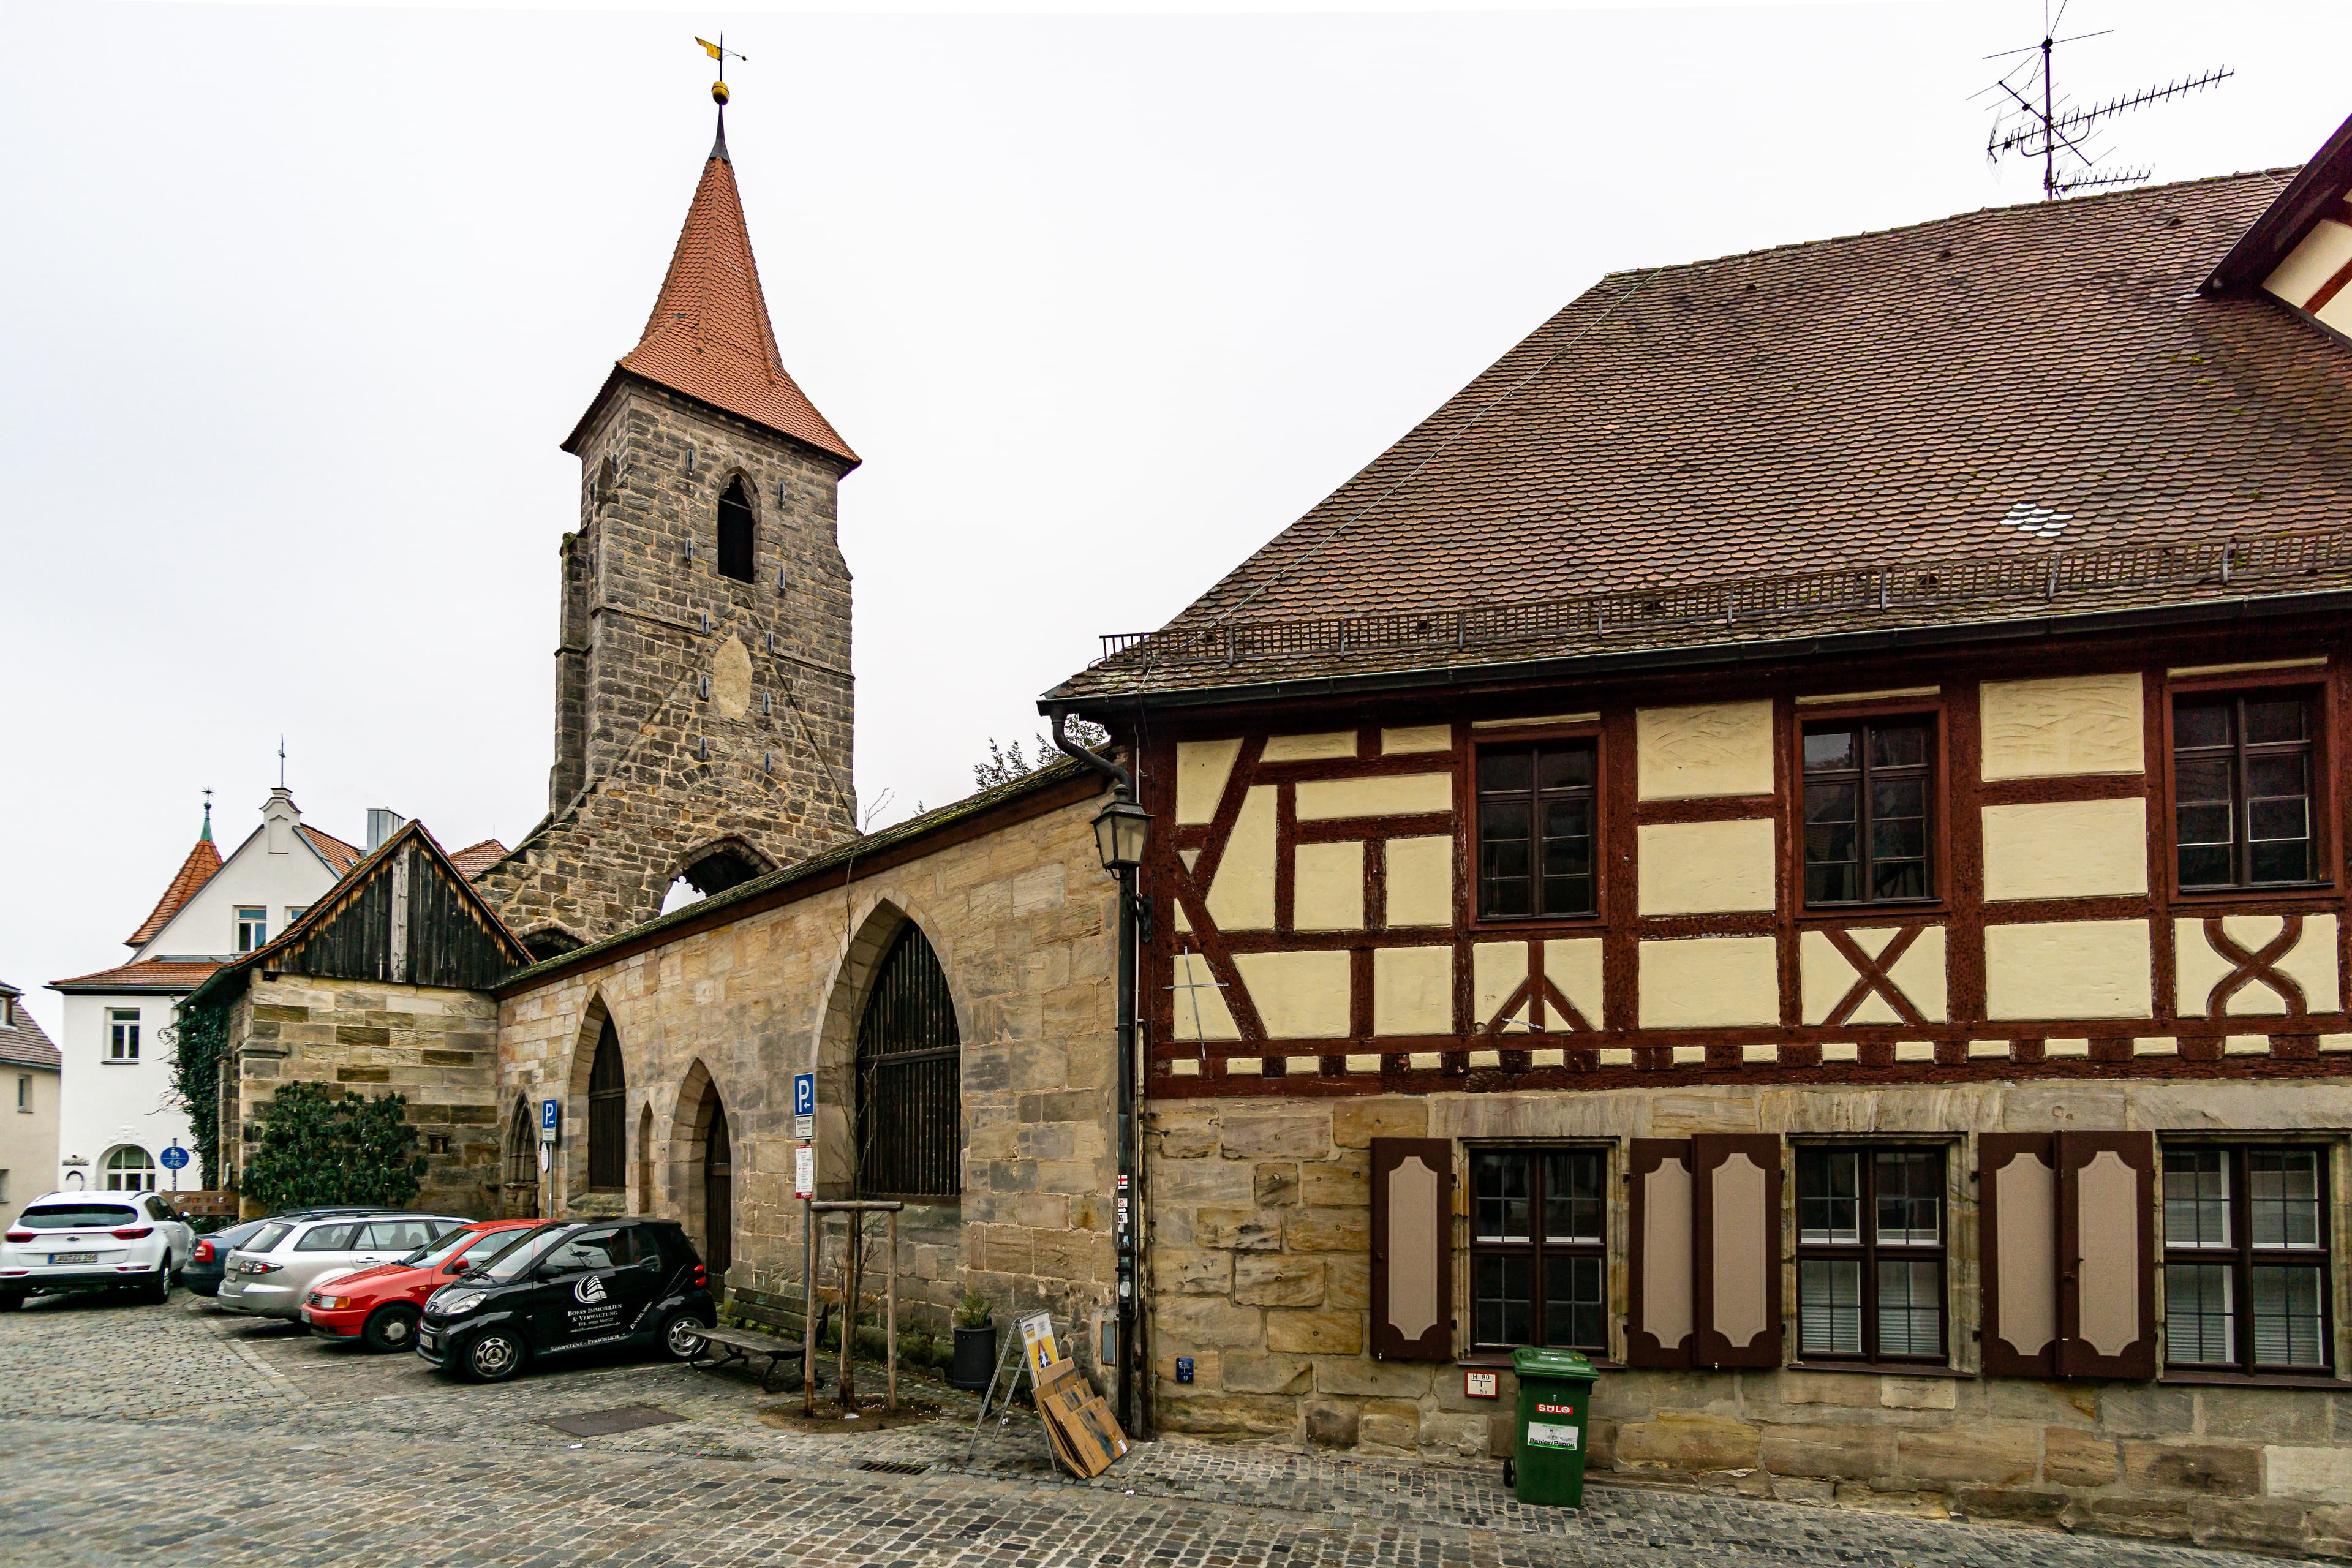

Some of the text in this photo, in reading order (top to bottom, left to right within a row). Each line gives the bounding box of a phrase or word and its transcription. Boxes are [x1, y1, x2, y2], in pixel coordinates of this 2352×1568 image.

[799, 1080, 809, 1112] P
[545, 1103, 554, 1125] P
[1529, 1438, 1575, 1448] Papier/Pappe
